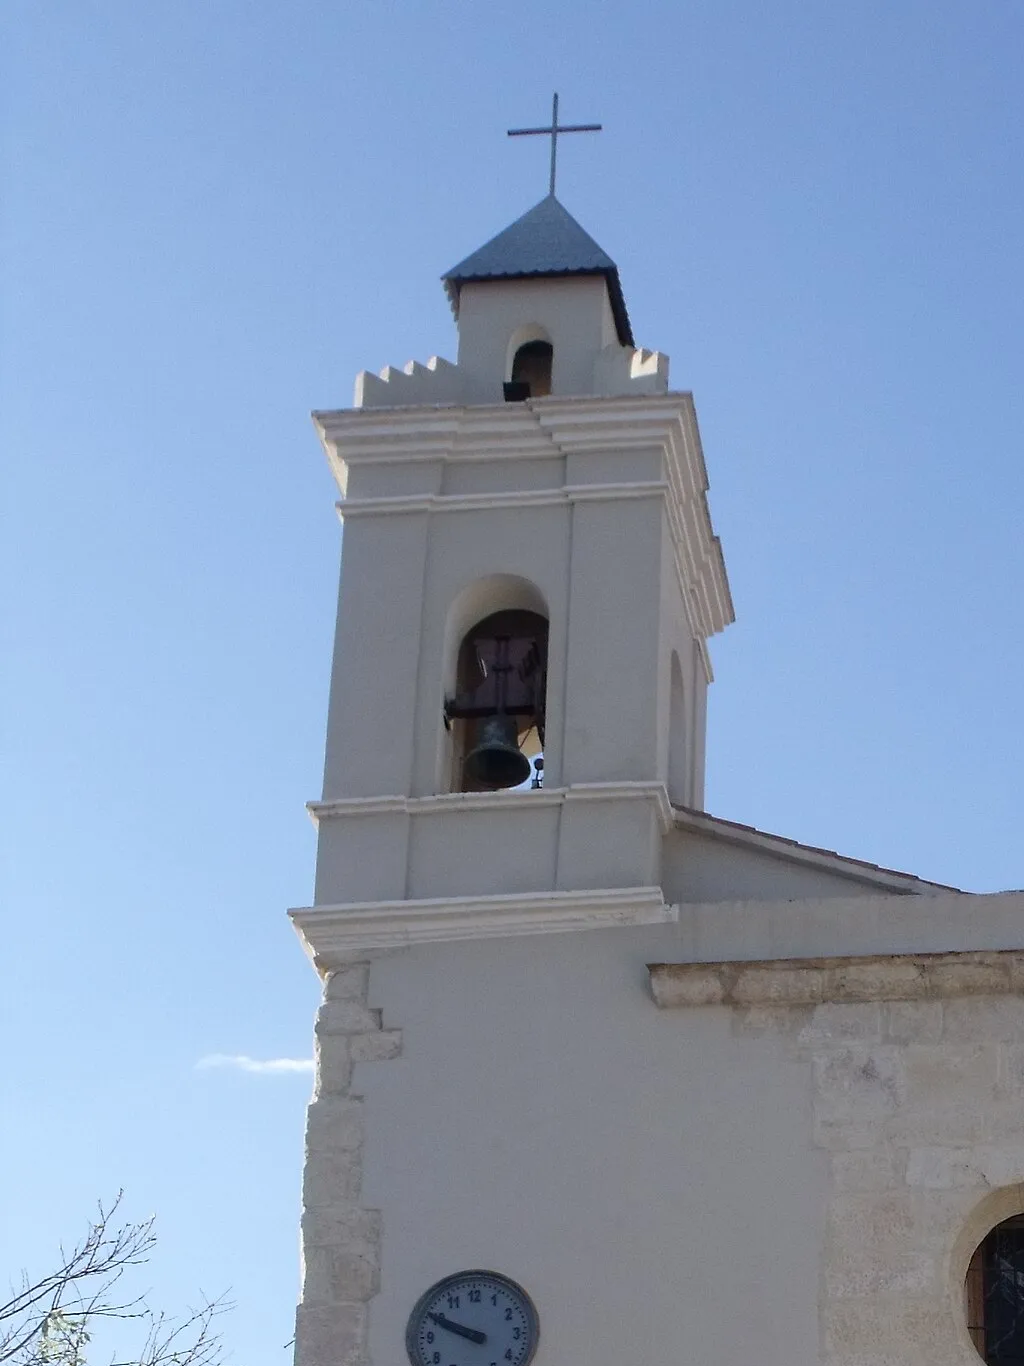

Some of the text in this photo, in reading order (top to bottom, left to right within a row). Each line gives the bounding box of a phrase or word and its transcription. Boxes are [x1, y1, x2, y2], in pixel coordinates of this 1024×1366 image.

[447, 1296, 460, 1308] 11
[468, 1290, 481, 1302] 12
[491, 1294, 497, 1306] 1
[505, 1309, 512, 1321] 2
[427, 1332, 434, 1344] 9
[513, 1327, 520, 1339] 3
[433, 1352, 440, 1364] 8
[505, 1348, 512, 1360] 4
